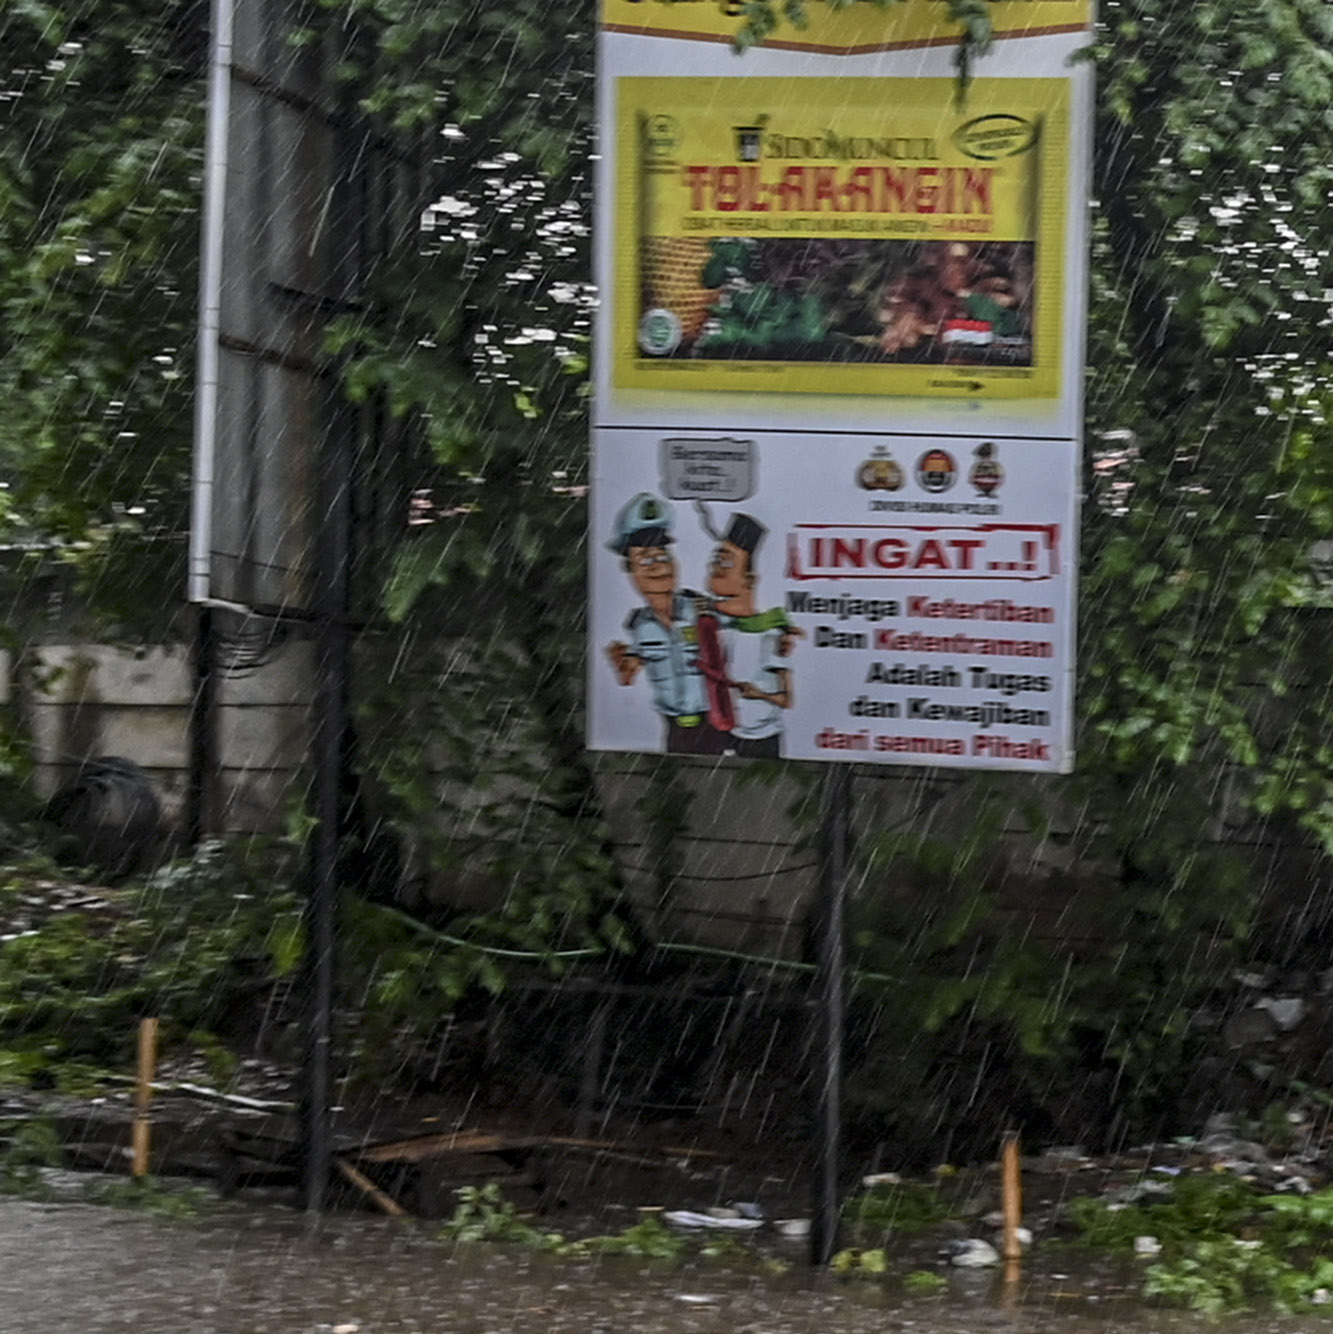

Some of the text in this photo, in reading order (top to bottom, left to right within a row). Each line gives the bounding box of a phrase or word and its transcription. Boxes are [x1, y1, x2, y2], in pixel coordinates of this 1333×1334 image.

[786, 591, 1055, 624] Menjaga Ketertiban
[814, 625, 1054, 658] Dan Ketentraman
[864, 661, 1053, 696] Adalah Tugas
[849, 694, 1051, 729] dan Kewajiban
[814, 726, 1051, 761] dari semua Pihak
